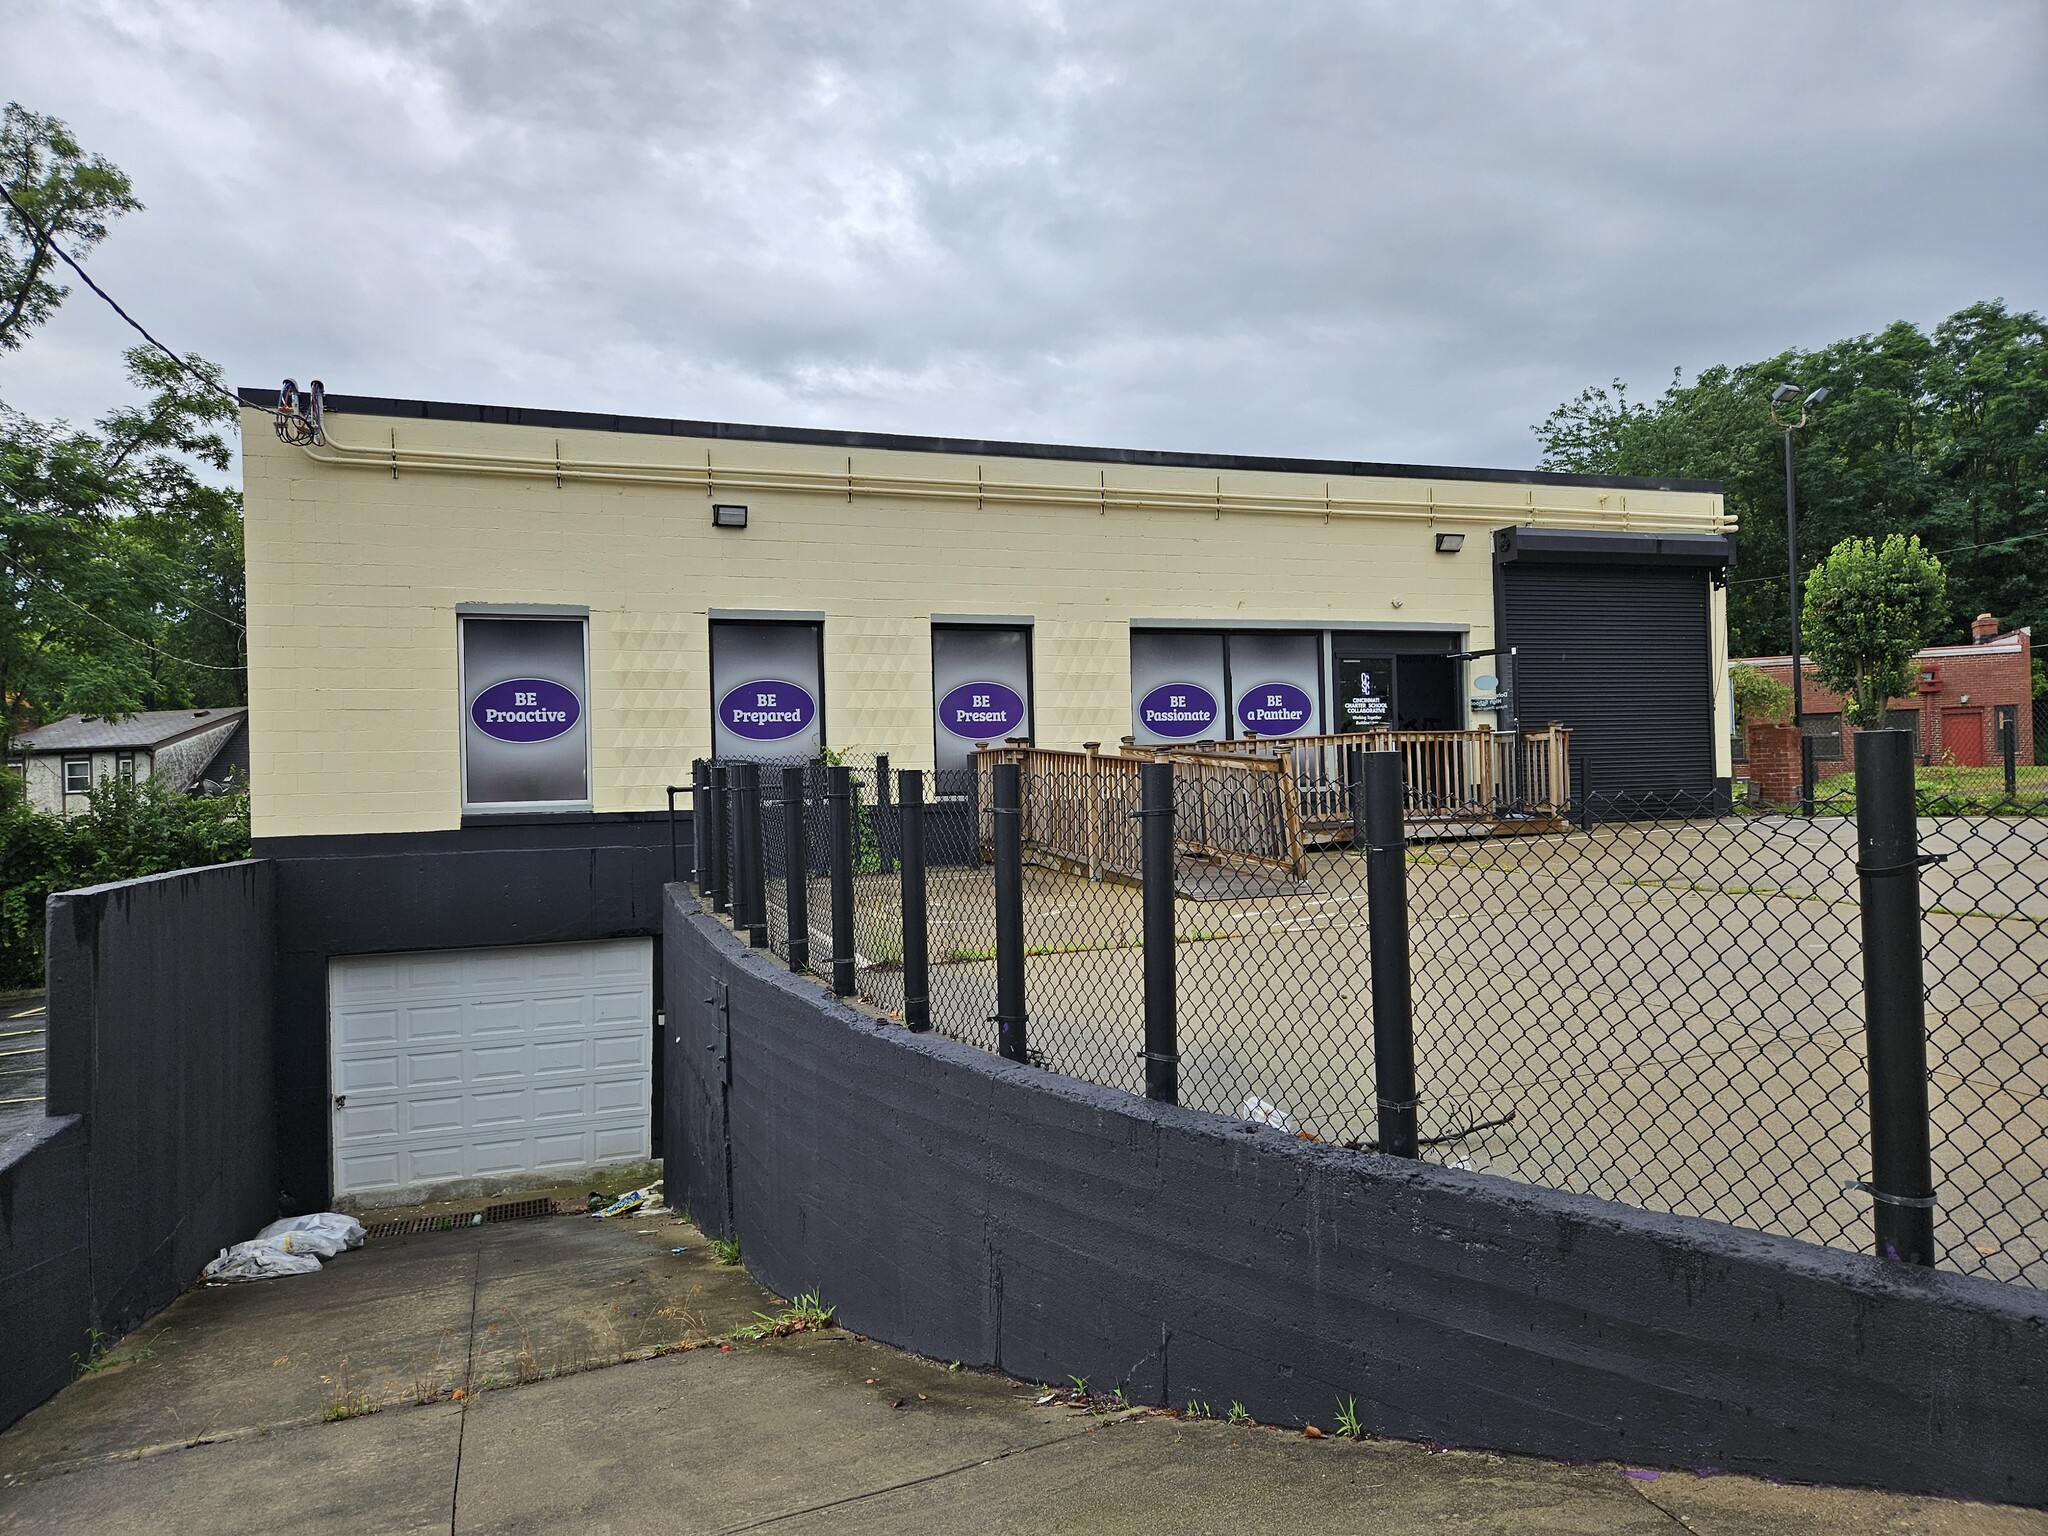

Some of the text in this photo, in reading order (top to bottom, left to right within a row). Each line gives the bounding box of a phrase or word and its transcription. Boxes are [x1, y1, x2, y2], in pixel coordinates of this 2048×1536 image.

[515, 692, 537, 706] BE
[757, 694, 777, 707] BE
[972, 695, 990, 708] BE
[1169, 696, 1187, 708] BE
[1266, 695, 1283, 707] BE
[485, 707, 566, 722] Proactive
[732, 708, 802, 726] Prepared
[956, 710, 1007, 722] Present
[1146, 709, 1211, 722] Passionate
[1247, 708, 1303, 721] a Panther
